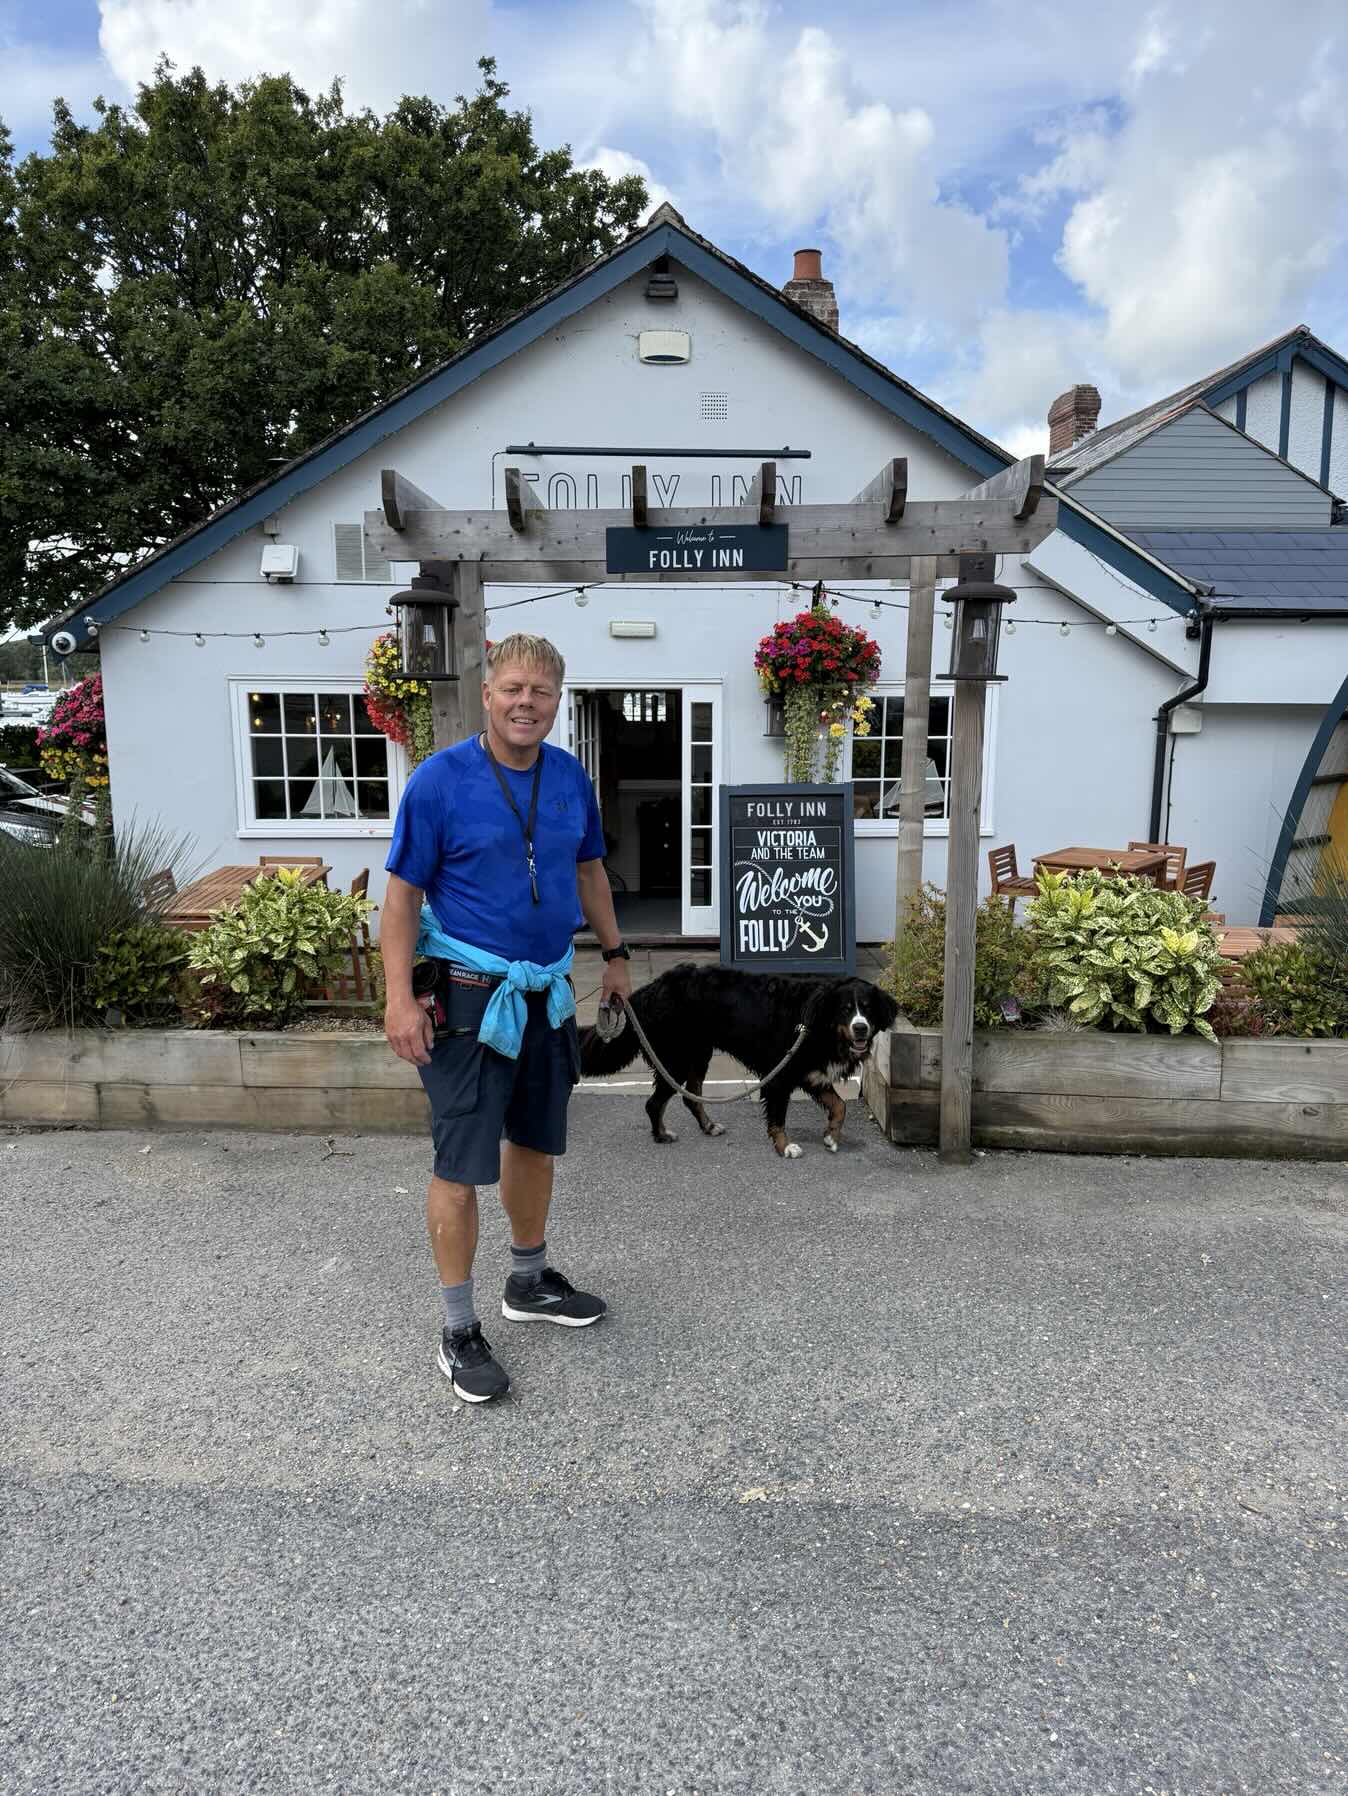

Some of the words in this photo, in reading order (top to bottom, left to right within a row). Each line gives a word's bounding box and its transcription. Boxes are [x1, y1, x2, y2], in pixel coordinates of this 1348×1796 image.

[521, 472, 681, 509] OLLY
[676, 529, 707, 545] Welcome
[707, 529, 715, 543] to
[649, 549, 704, 568] FOLLY
[712, 548, 744, 567] INN
[747, 802, 793, 817] FOLLY
[800, 801, 826, 817] INN
[757, 830, 817, 847] VICTORIA
[751, 847, 770, 860] AND
[773, 847, 794, 860] THE
[796, 847, 826, 860] TEAM
[736, 867, 838, 914] Welcome
[793, 895, 822, 907] YOU
[739, 919, 790, 953] FOLLY
